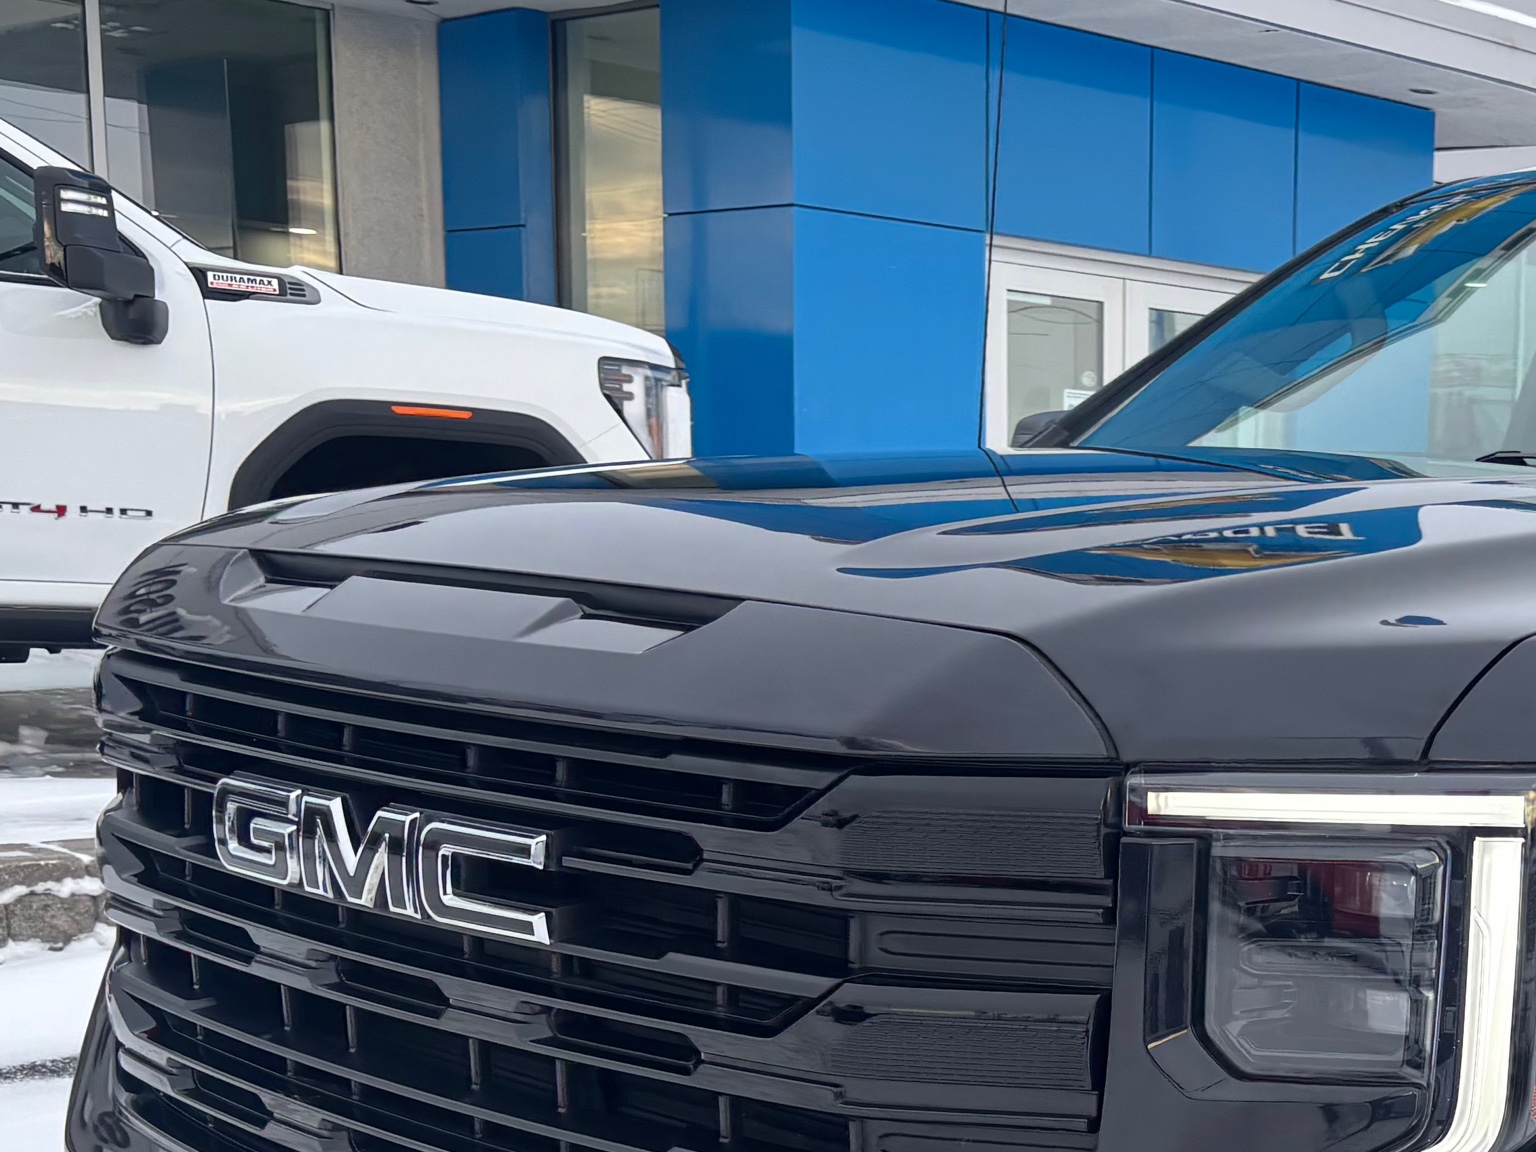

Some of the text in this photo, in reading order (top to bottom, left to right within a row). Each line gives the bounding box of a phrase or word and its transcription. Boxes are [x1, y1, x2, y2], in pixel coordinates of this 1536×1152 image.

[213, 274, 274, 288] DURAMAX
[0, 502, 153, 519] T4 HD
[213, 776, 551, 945] GMC
